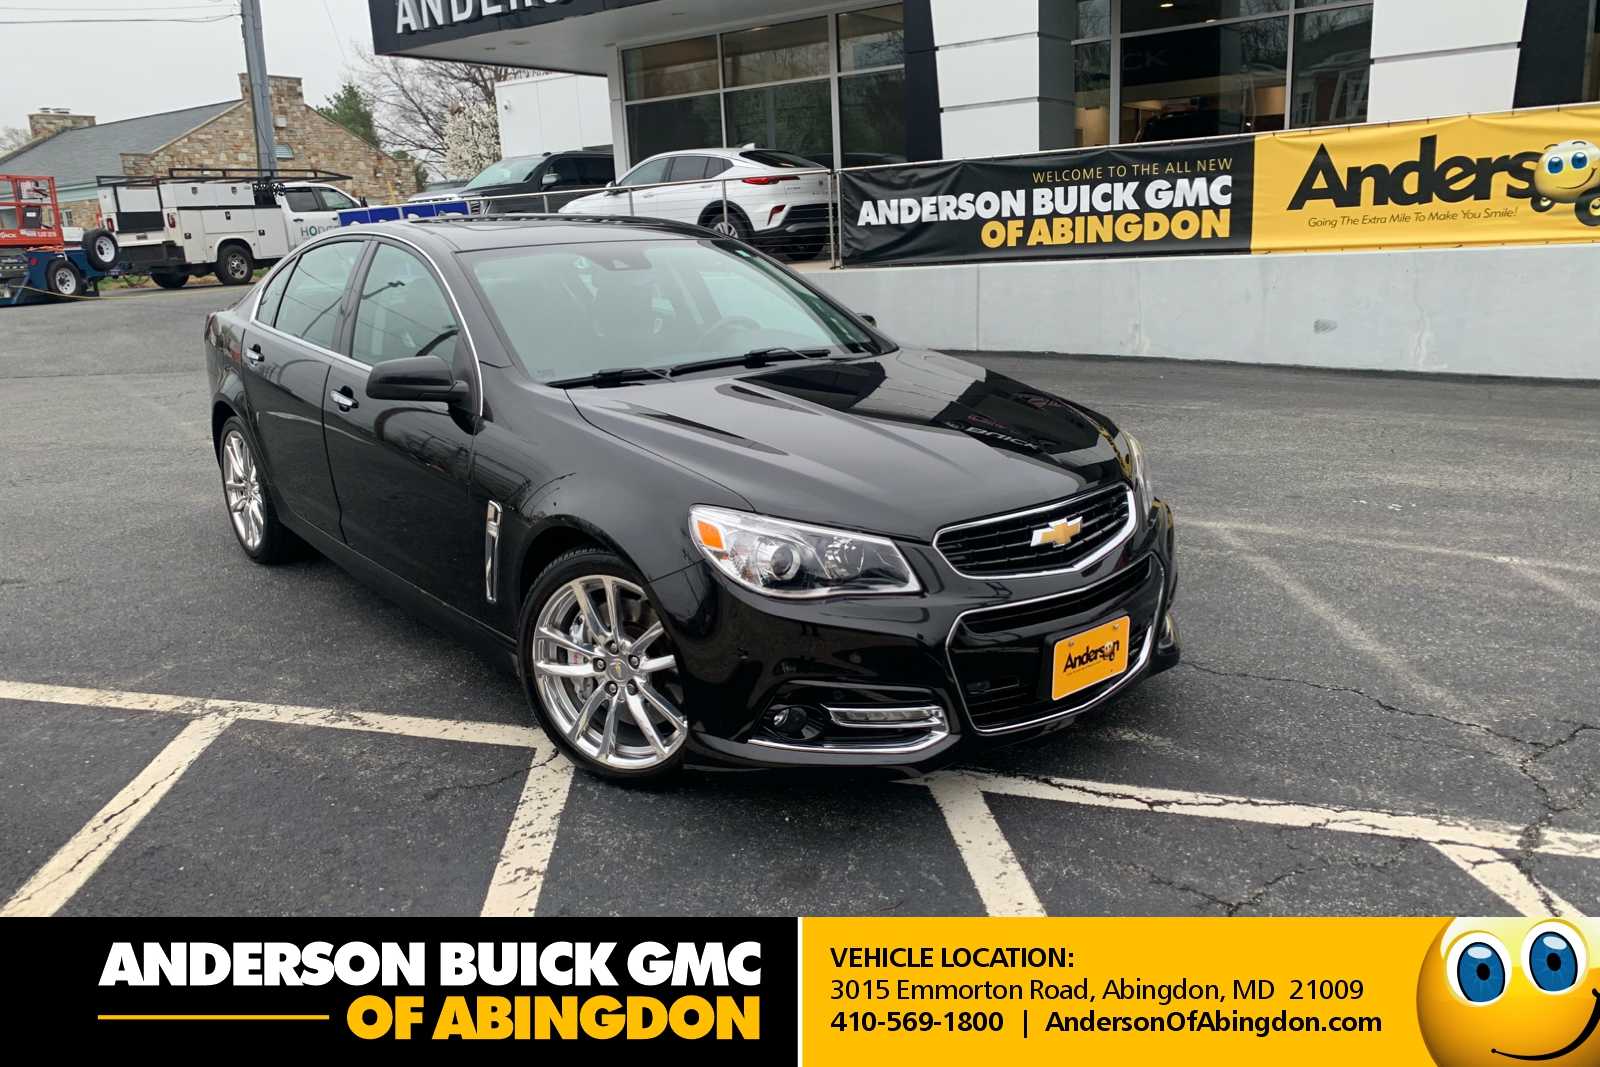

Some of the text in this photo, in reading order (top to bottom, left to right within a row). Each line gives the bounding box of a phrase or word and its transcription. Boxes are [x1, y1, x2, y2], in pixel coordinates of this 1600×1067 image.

[1033, 158, 1232, 184] WELCOME TO THE ALL NEW
[857, 175, 1232, 227] ANDERSON BUICK GMC
[1308, 206, 1518, 229] Going The Extra Mile To Make You Smile!
[981, 208, 1231, 248] OF ABINGDON
